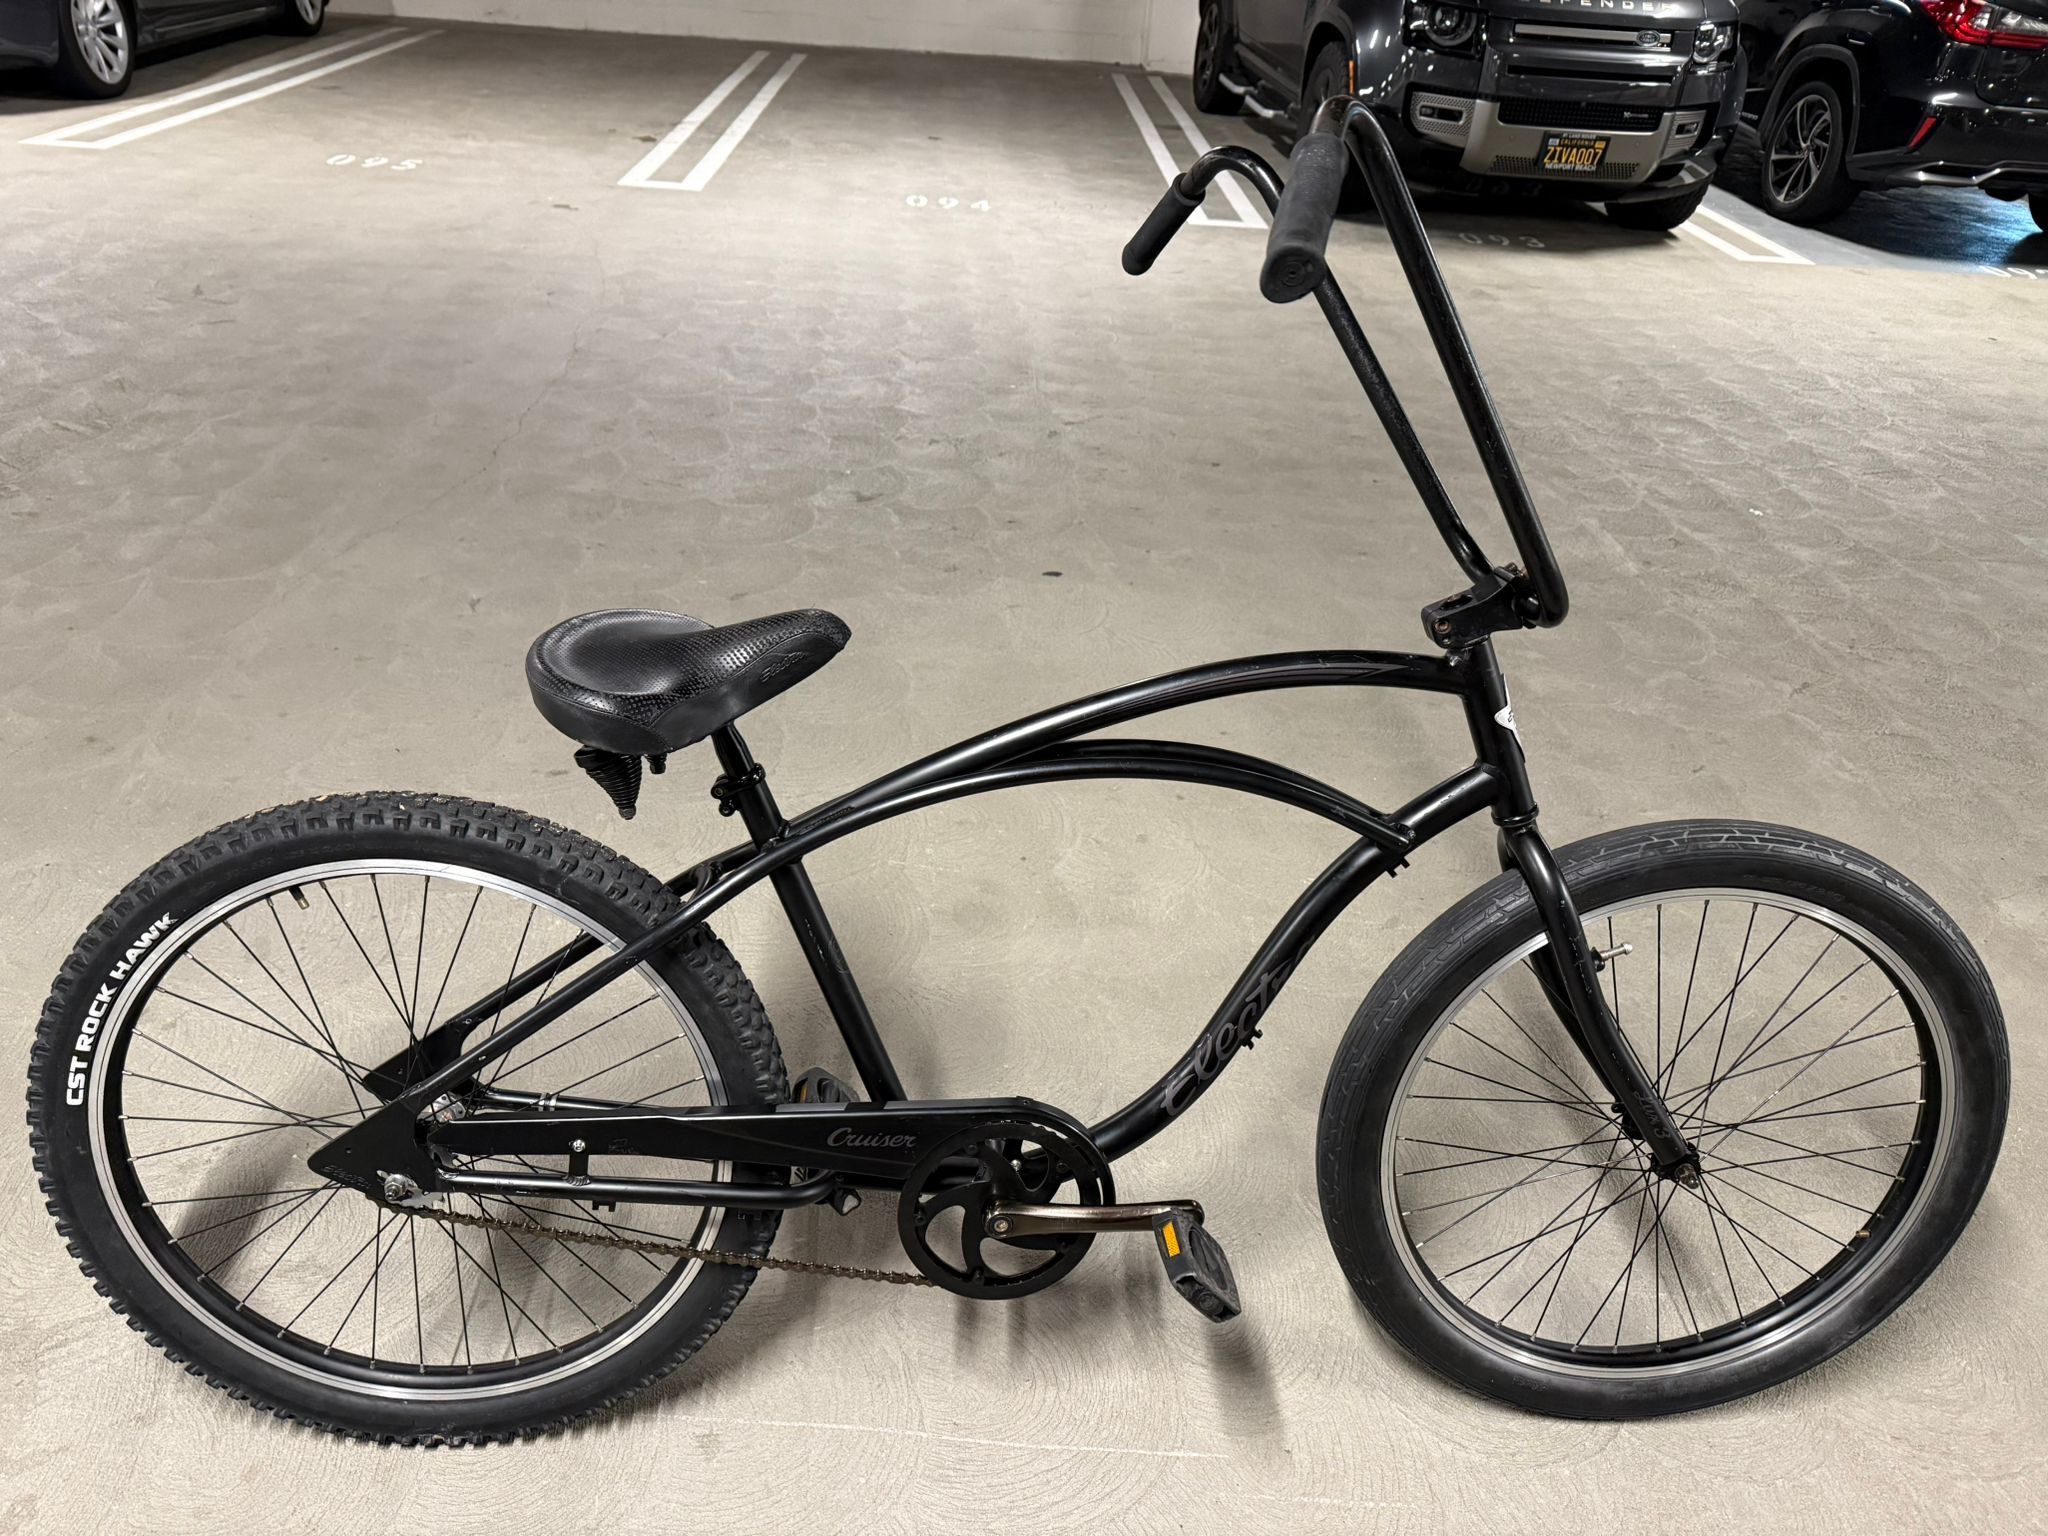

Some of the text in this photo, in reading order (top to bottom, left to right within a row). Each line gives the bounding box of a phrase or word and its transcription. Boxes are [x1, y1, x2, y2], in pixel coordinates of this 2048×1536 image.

[326, 154, 423, 171] 095
[906, 195, 992, 211] 094
[1459, 233, 1545, 249] 093
[66, 912, 179, 1106] CST ROCK HAWK
[827, 1127, 917, 1148] Cruiser
